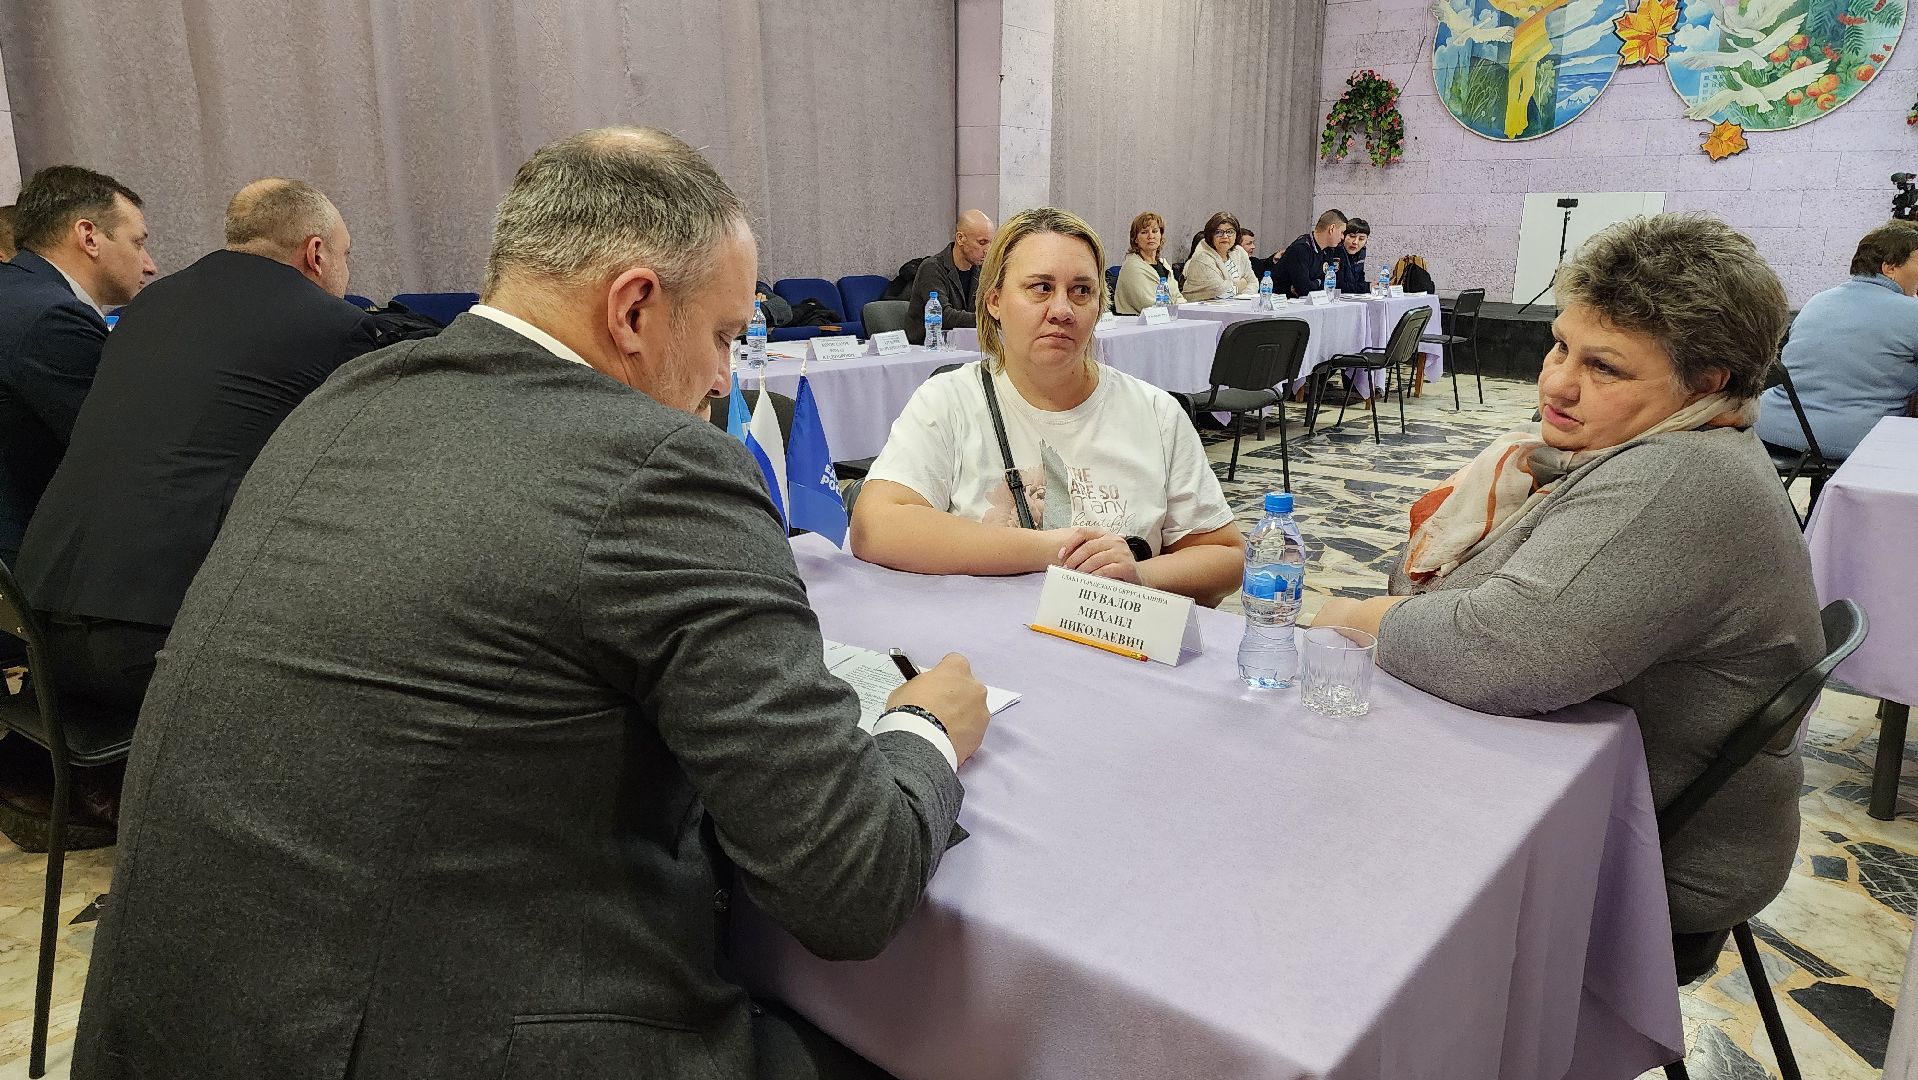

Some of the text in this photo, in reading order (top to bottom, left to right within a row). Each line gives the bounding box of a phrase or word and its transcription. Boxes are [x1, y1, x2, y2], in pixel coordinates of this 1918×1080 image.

[1098, 484, 1119, 499] SO
[1072, 495, 1128, 517] many
[1078, 588, 1142, 613] ШУВАЛОВ
[1077, 605, 1133, 629] МИХАИЛ
[1059, 618, 1145, 650] НИКОЛАЕВИЧ
